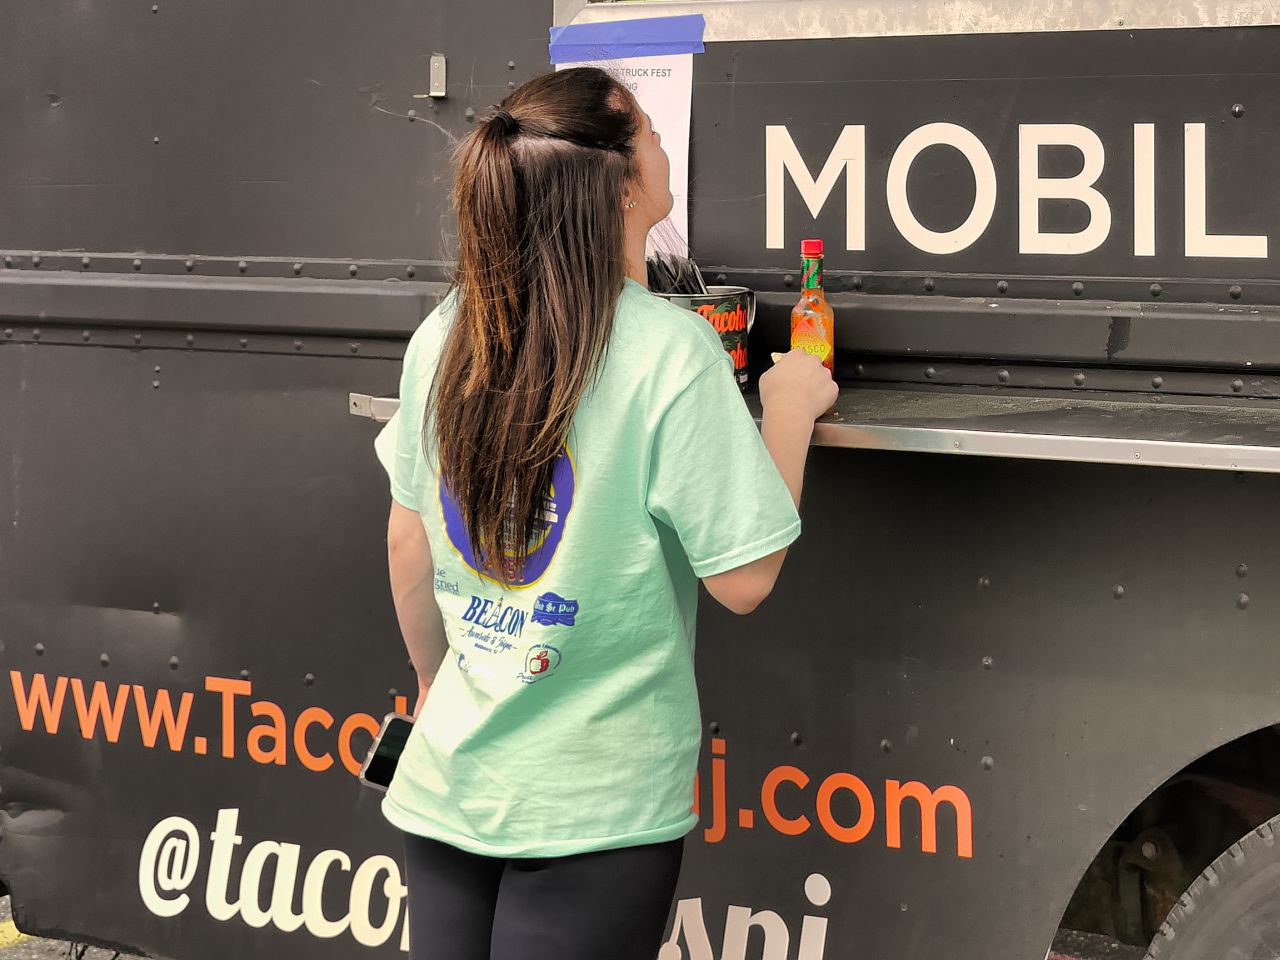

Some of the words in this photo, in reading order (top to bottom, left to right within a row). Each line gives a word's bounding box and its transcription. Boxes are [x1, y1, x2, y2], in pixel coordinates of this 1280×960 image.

[621, 68, 649, 77] TRUCK
[651, 68, 672, 77] FEST
[461, 595, 529, 638] BEACON
